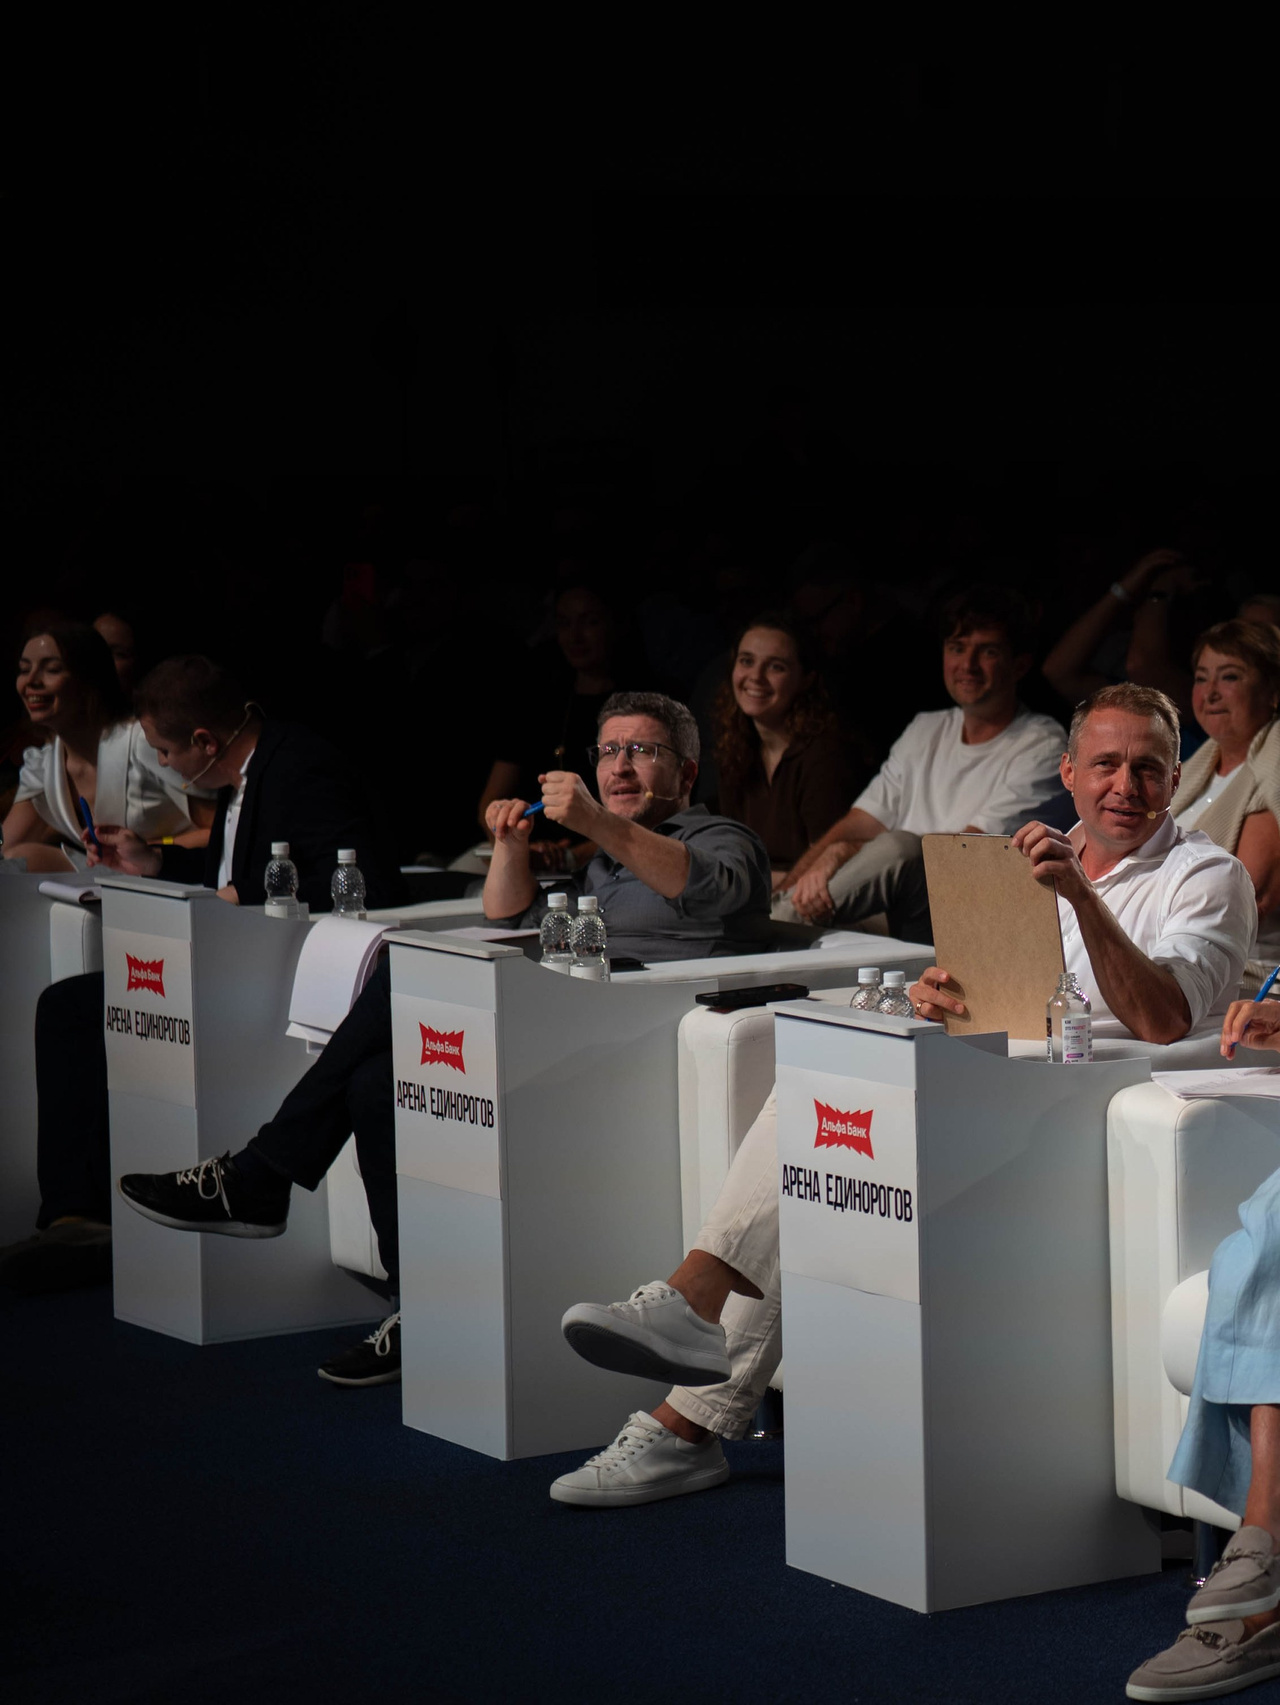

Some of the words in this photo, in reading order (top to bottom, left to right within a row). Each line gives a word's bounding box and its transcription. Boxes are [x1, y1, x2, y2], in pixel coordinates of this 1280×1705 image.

[130, 966, 147, 982] Альфа
[147, 969, 161, 982] Банк
[106, 1005, 132, 1035] АРЕНА
[135, 1011, 190, 1046] ЕДИНОРОГОВ
[425, 1037, 444, 1055] Альфа
[444, 1041, 460, 1056] Банк
[397, 1080, 427, 1114] АРЕНА
[430, 1087, 494, 1129] ЕДИНОРОГОВ
[821, 1117, 847, 1136] Альфа
[847, 1121, 867, 1138] Банк
[782, 1164, 821, 1203] АРЕНА
[826, 1173, 913, 1222] ЕДИНОРОГОВ
